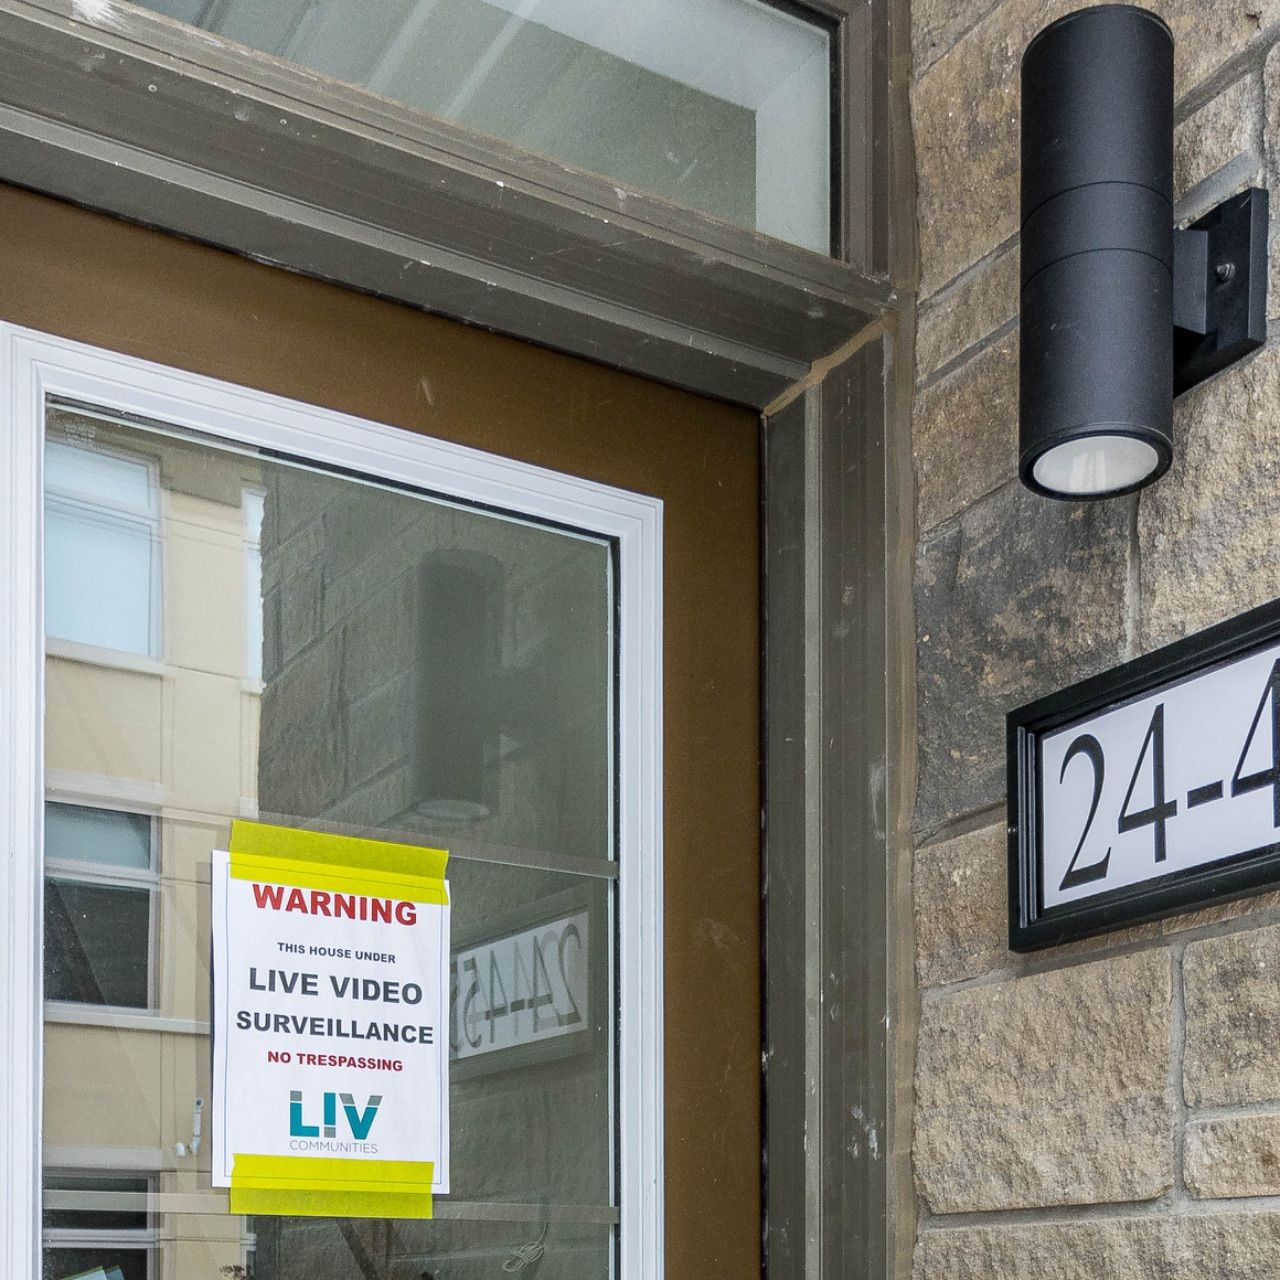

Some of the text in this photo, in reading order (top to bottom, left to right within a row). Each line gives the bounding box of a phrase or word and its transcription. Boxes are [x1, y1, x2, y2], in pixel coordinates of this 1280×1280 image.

[252, 883, 418, 926] WARNING
[277, 942, 396, 964] THIS HOUSE UNDER
[249, 967, 423, 1005] LIVE VIDEO
[236, 1011, 434, 1045] SURVEILLANCE
[267, 1051, 403, 1072] NO TRESPASSING
[289, 1090, 383, 1140] LIV
[289, 1139, 378, 1154] COMMUNITIES
